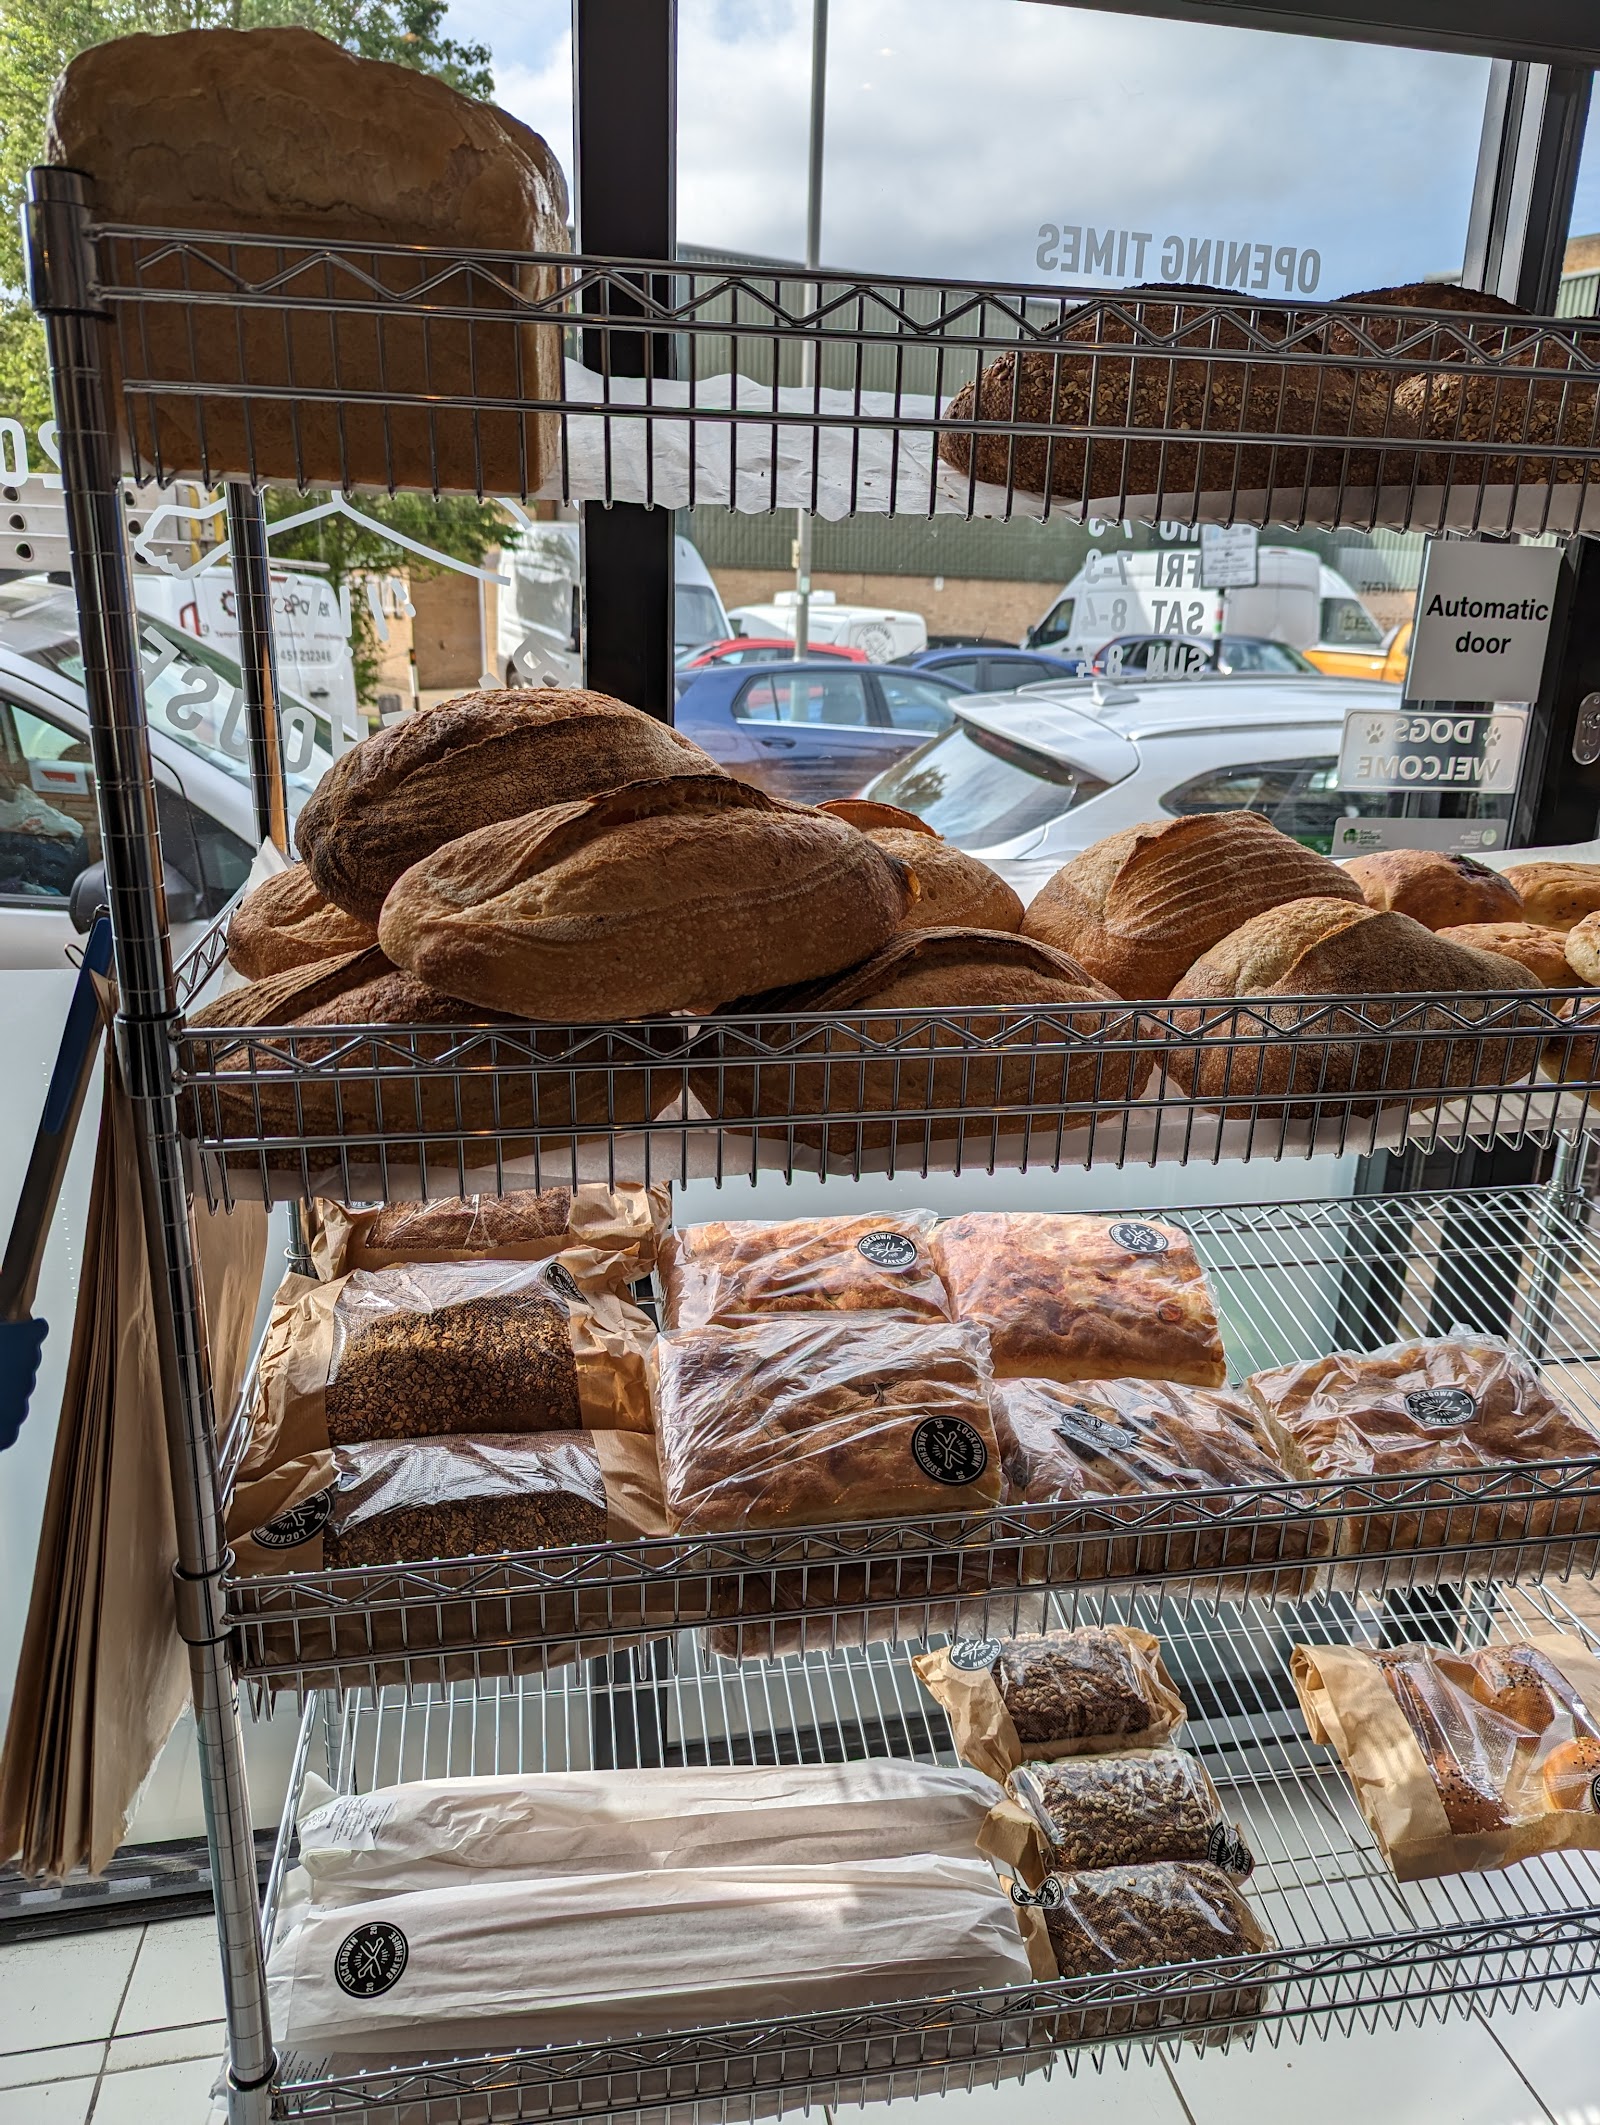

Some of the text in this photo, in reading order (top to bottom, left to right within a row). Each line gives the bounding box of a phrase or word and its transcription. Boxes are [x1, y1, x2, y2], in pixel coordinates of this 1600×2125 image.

[1426, 594, 1549, 621] Automatic
[1455, 631, 1512, 654] door
[861, 1234, 892, 1249] LOCKDOWN
[882, 1251, 913, 1264] BAKEHOUSE
[1410, 1391, 1454, 1403] LOCKDOWN
[935, 1419, 944, 1429] 20
[1425, 1411, 1470, 1423] BAKEHOUSE
[918, 1431, 943, 1476] BAKEHOUSE
[956, 1423, 983, 1468] LOCKDOWN
[956, 1470, 966, 1480] 20
[256, 1526, 307, 1544] LOCKDOWN
[972, 1645, 999, 1668] LOCKDOWN
[1211, 1828, 1226, 1864] CKDOWN
[369, 1925, 378, 1935] 20
[340, 1936, 359, 1987] LOCKDOWN
[385, 1931, 404, 1981] BAKEHOUSE
[366, 1981, 375, 1992] 20
